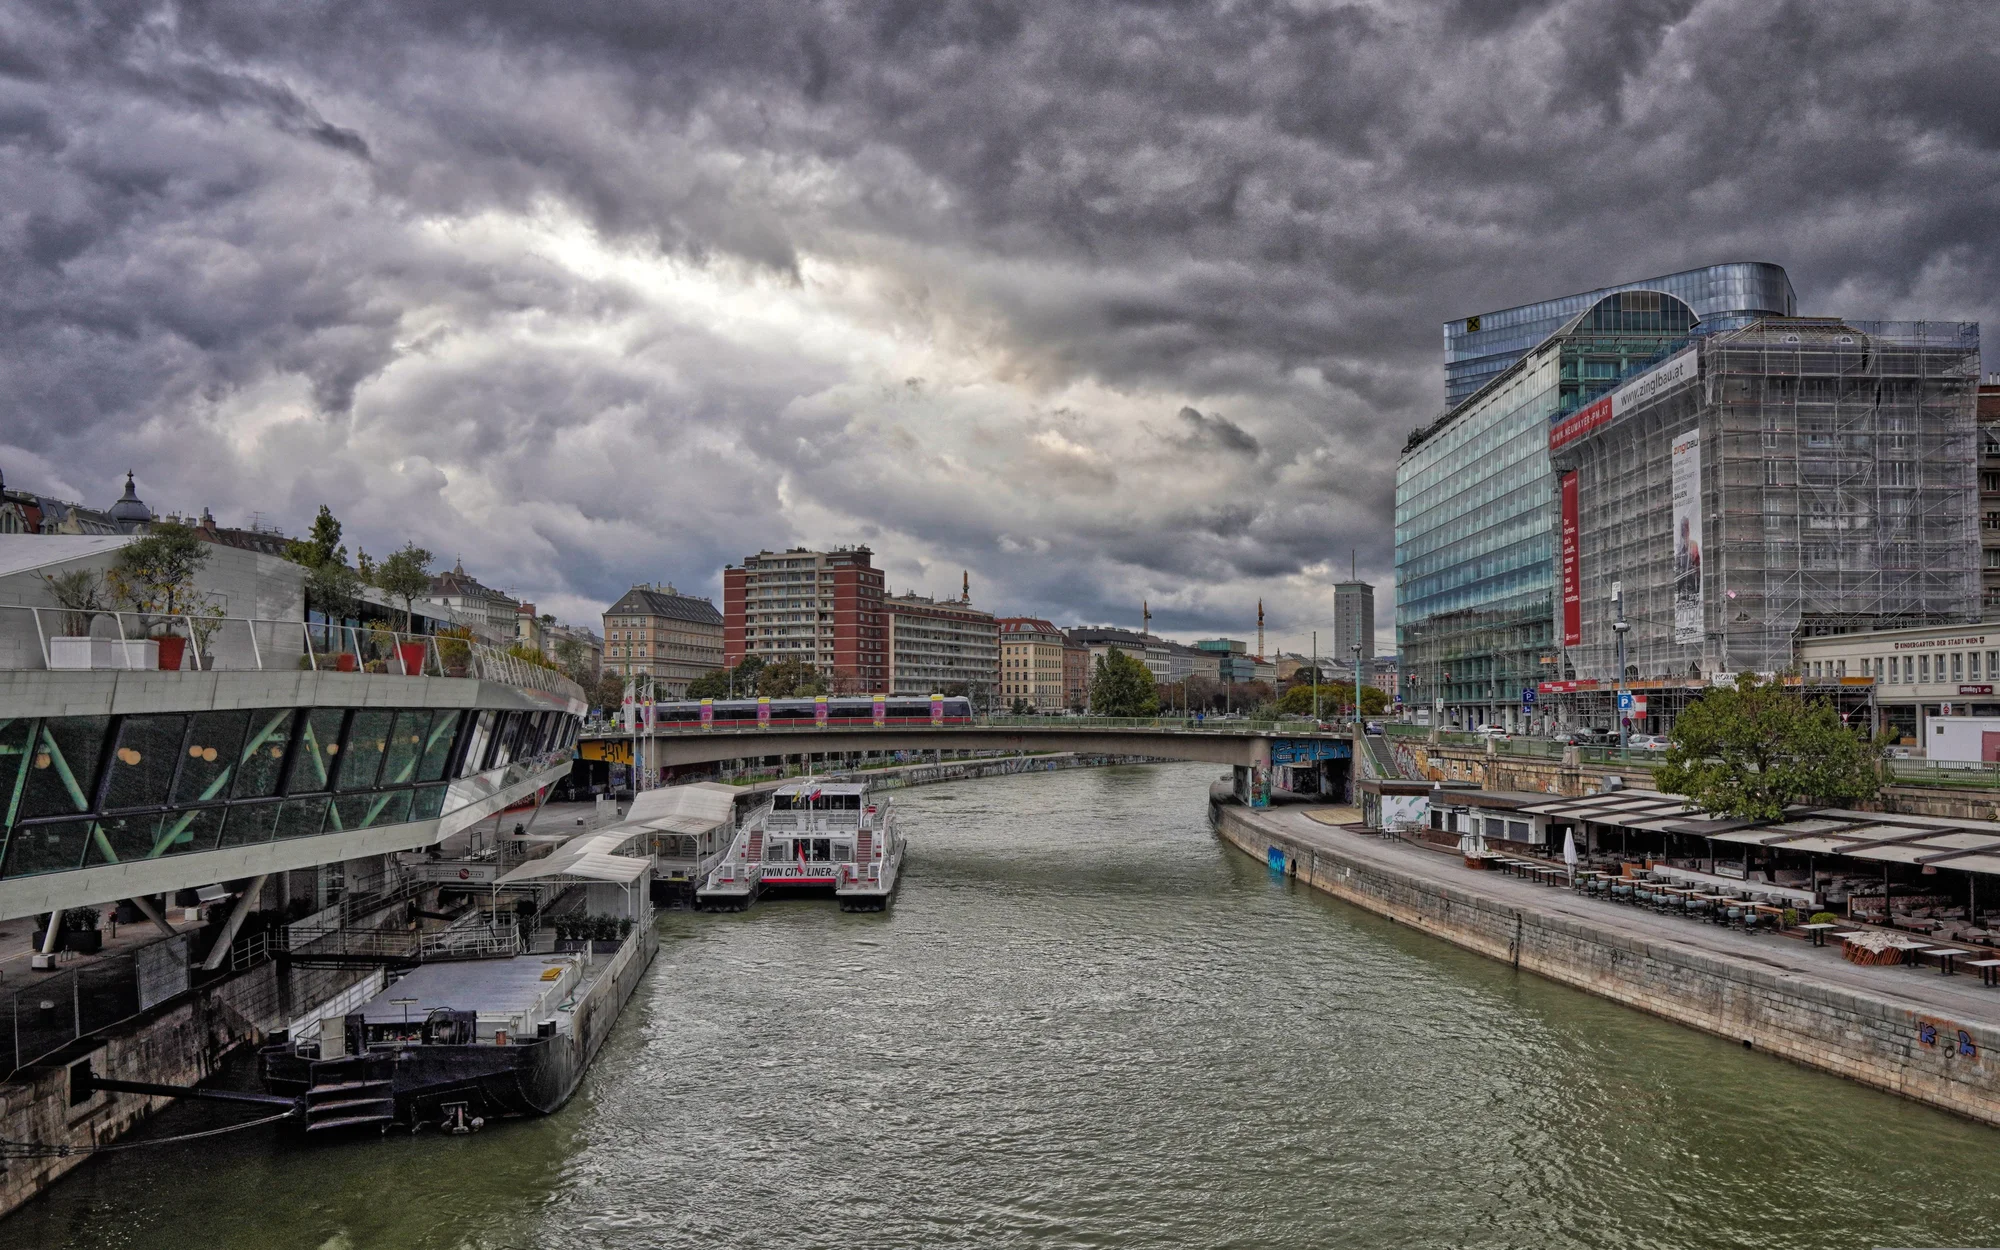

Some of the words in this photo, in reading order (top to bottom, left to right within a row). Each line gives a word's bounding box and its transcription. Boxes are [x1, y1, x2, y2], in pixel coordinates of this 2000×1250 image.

[1620, 362, 1683, 406] www.zinglbau.at
[1551, 405, 1608, 443] WWW.NEUMAYER-PM.AT
[1900, 641, 1935, 649] KINDERGARTEN
[1937, 639, 1946, 647] DER
[1961, 686, 1981, 694] smokey's
[1621, 698, 1628, 707] P
[761, 867, 783, 877] TWIN
[785, 867, 804, 877] CIT
